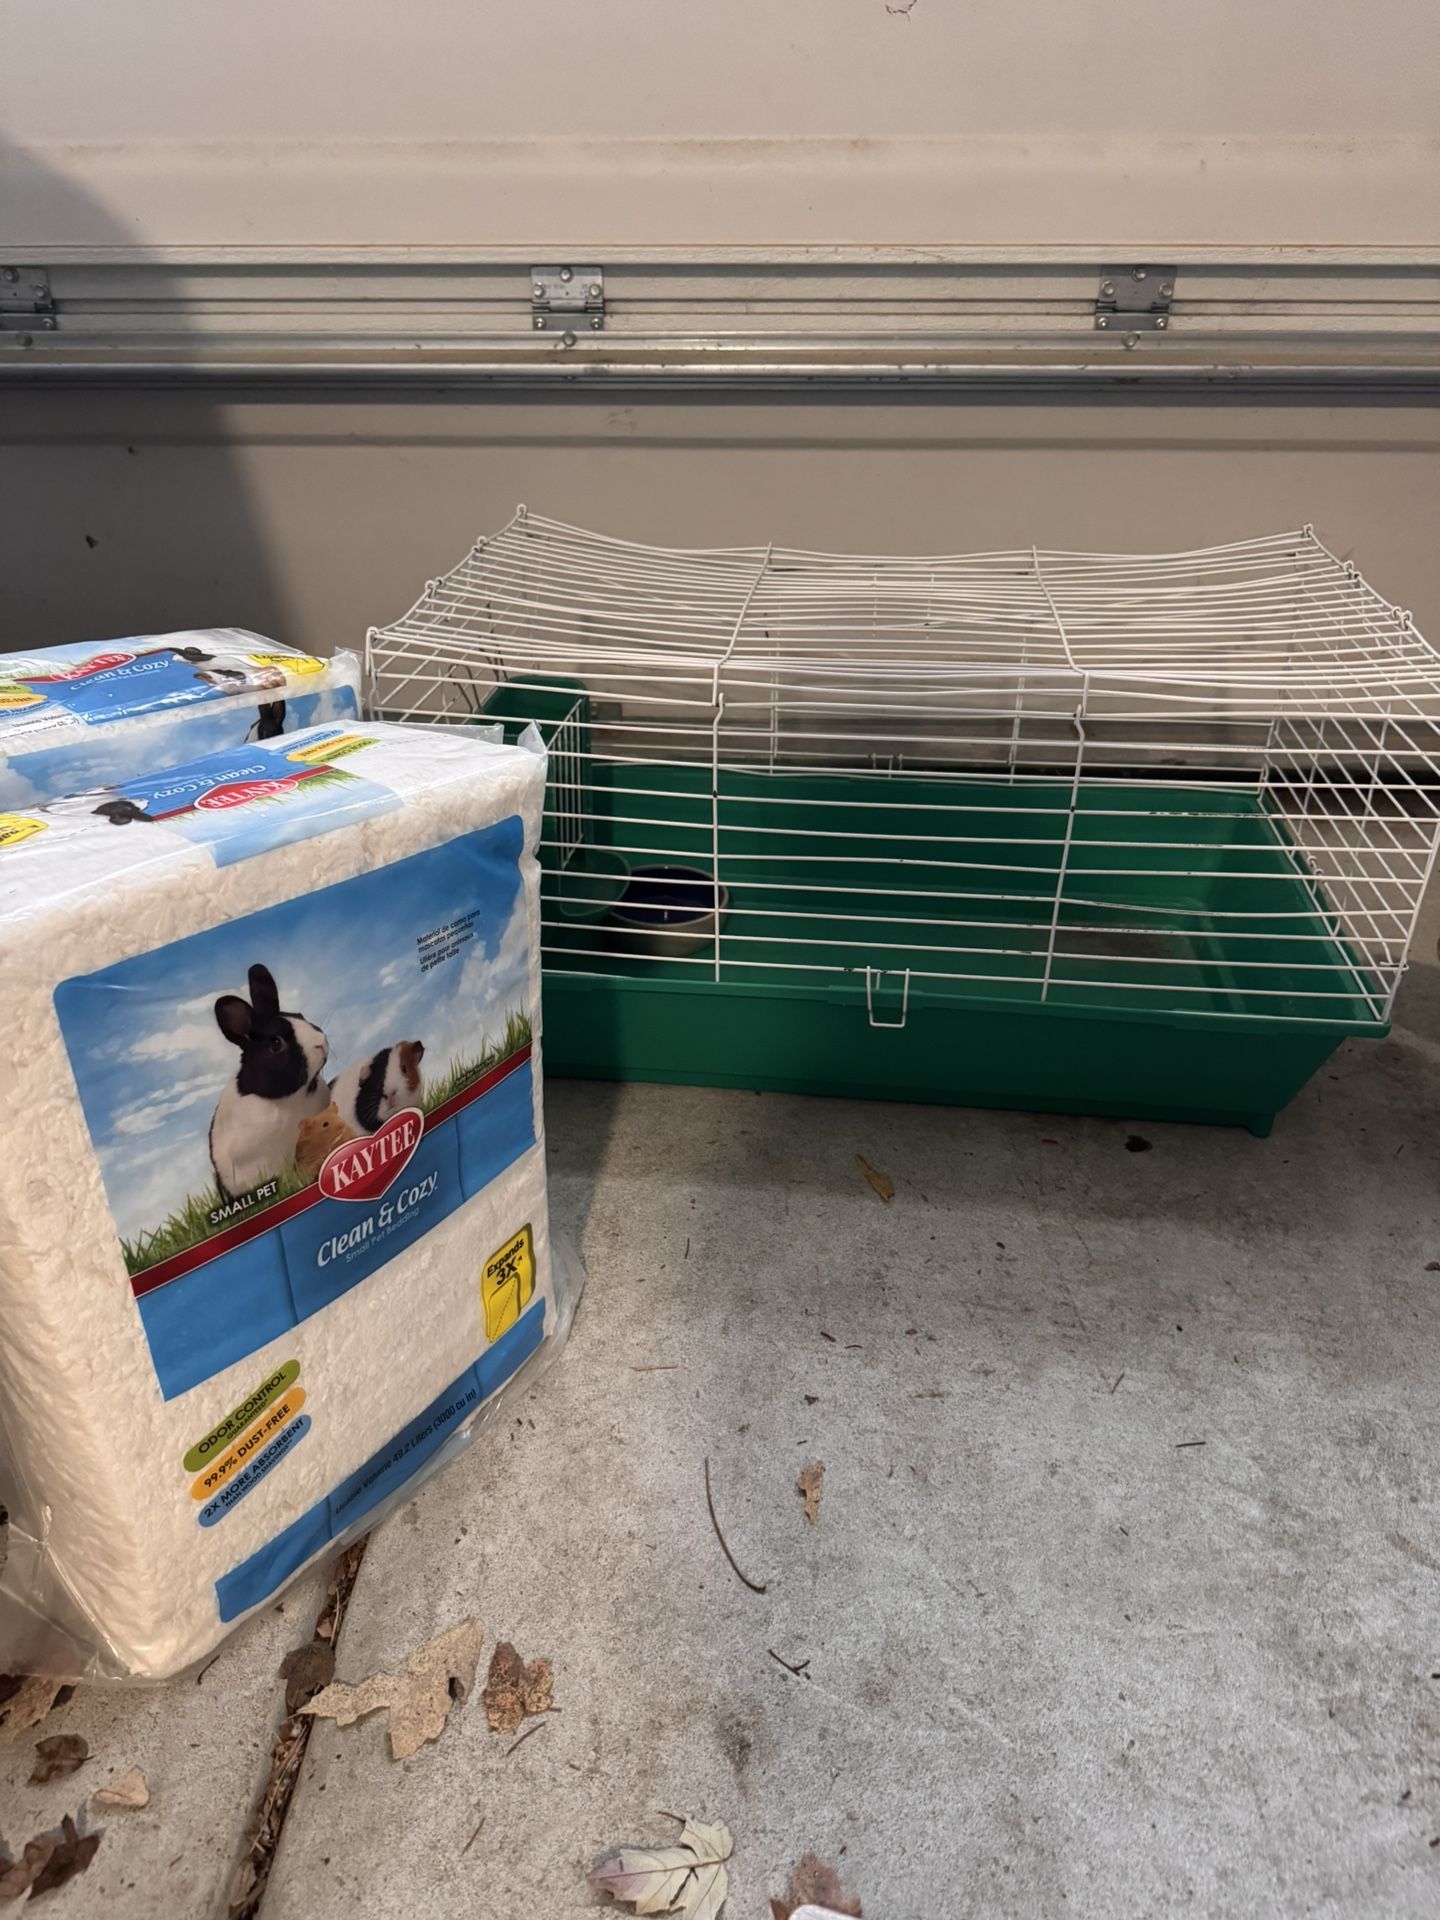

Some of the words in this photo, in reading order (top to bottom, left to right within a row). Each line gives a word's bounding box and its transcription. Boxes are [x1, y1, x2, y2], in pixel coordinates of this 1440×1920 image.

[70, 671, 113, 690] Clean
[116, 667, 131, 676] &
[132, 660, 169, 673] Cozy
[153, 785, 198, 799] Cozy
[200, 779, 215, 787] &
[216, 765, 266, 781] Clean
[201, 781, 286, 807] KAYTEE
[330, 1120, 415, 1193] KAYTEE
[210, 1197, 254, 1224] SMALL
[257, 1181, 278, 1200] PET
[317, 1217, 373, 1268] Clean
[378, 1203, 394, 1229] &
[396, 1171, 438, 1211] Cozy
[345, 1243, 371, 1263] Small
[371, 1232, 385, 1246] Pet
[386, 1206, 419, 1234] Bedding
[487, 1238, 524, 1278] Expands
[198, 1420, 235, 1454] ODOR
[235, 1371, 287, 1421] CONTROL
[204, 1456, 238, 1488] 99.9%
[237, 1404, 290, 1458] DUST-FREE
[204, 1501, 221, 1519] 2X
[221, 1474, 252, 1503] MORE
[252, 1418, 305, 1473] ABSORBENT
[225, 1490, 243, 1508] THAN
